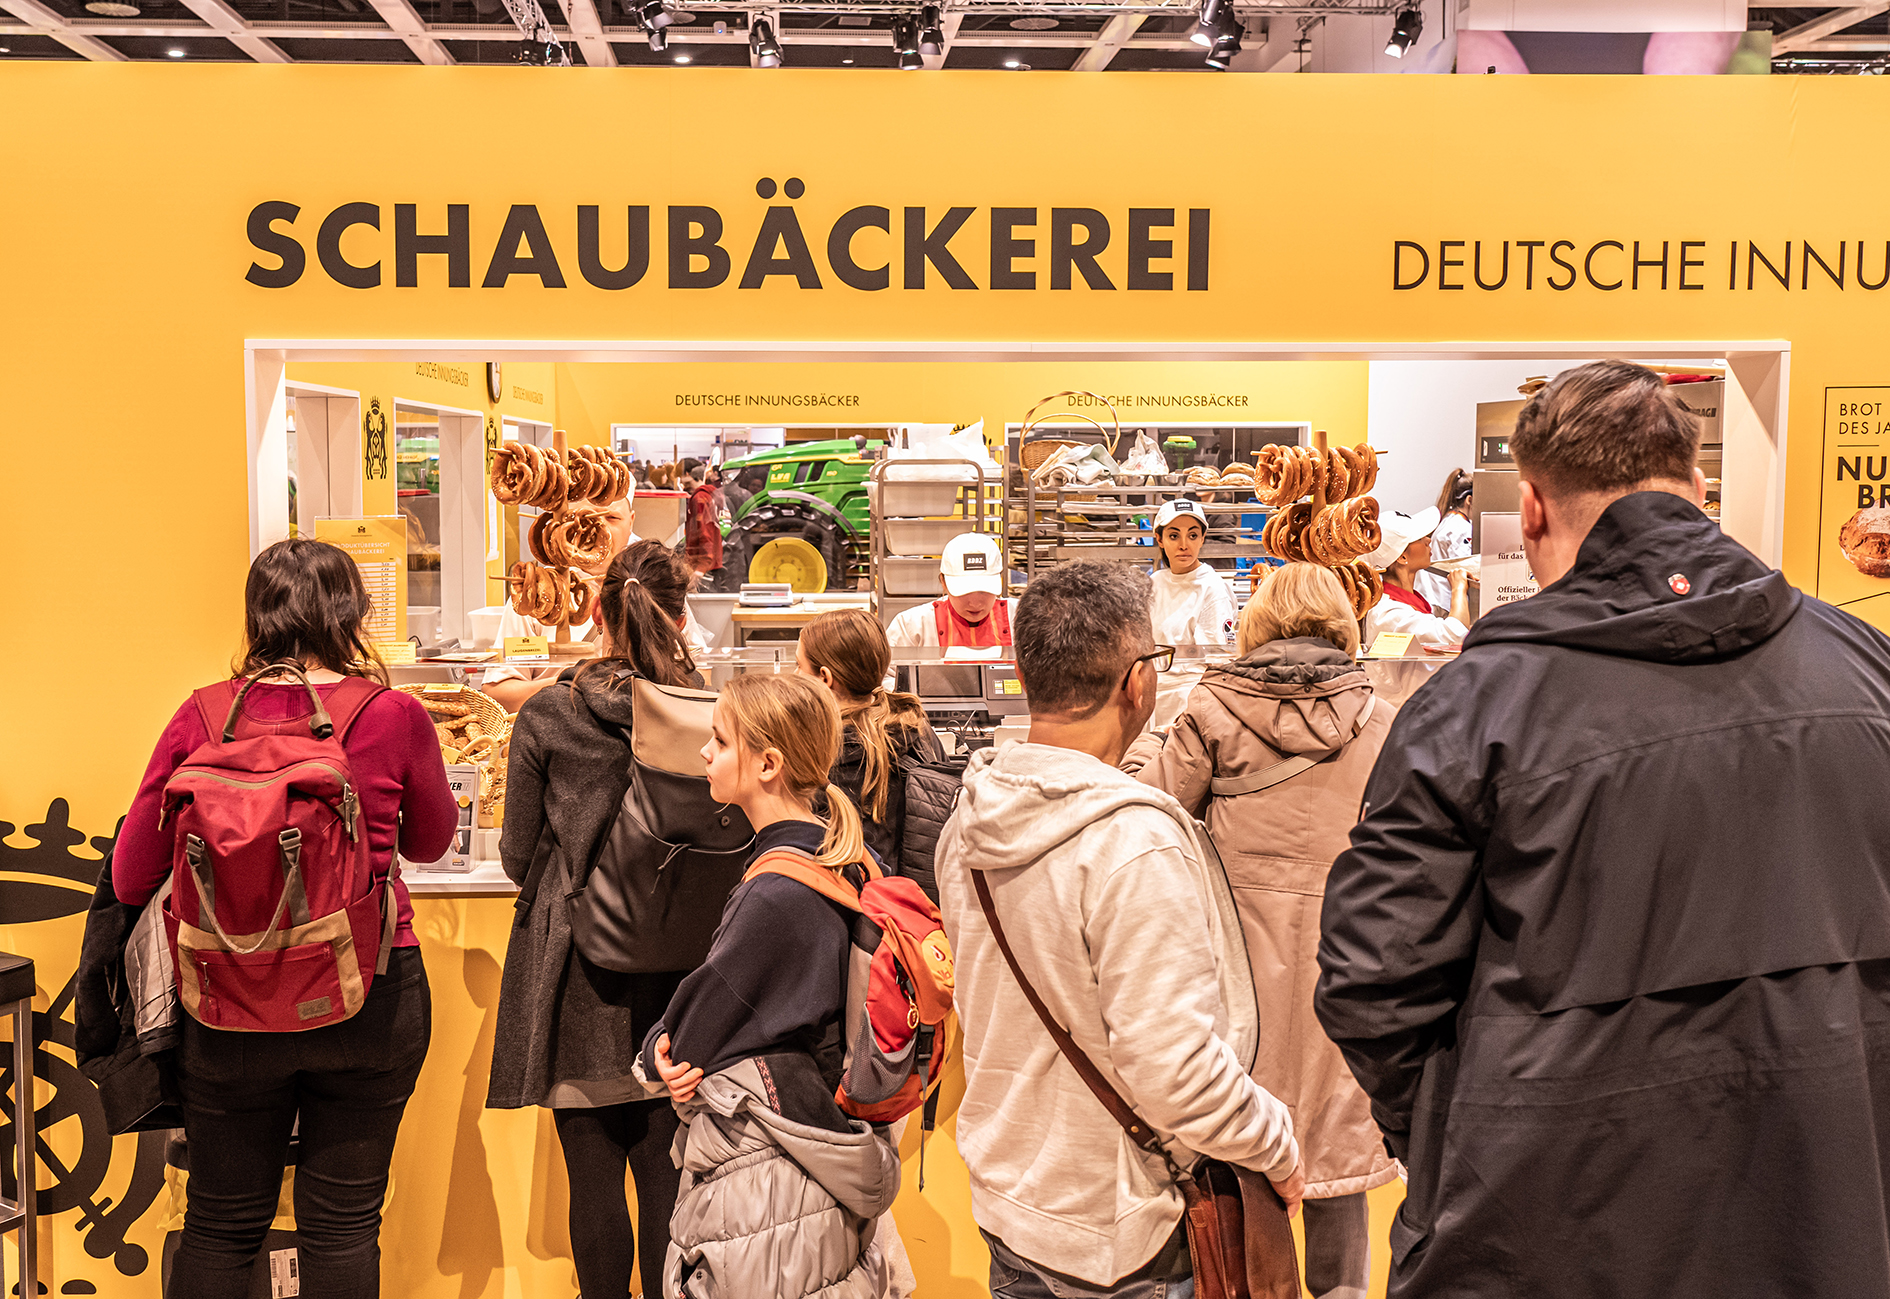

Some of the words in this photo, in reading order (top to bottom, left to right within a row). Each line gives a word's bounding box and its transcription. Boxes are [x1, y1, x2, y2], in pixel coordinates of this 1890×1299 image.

[245, 177, 1211, 291] SCHAUBÄCKEREI
[1393, 239, 1706, 292] DEUTSCHE
[1729, 239, 1890, 292] INNU
[675, 394, 741, 406] DEUTSCHE
[745, 392, 860, 407] INNUNGSBÄCKER
[1068, 395, 1132, 407] DEUTSCHE
[1136, 393, 1249, 407] INNUNGSBÄCKER
[1840, 402, 1882, 416] BROT
[1839, 421, 1869, 435] DES
[1836, 455, 1887, 481] NU
[1498, 552, 1509, 560] für
[1510, 552, 1524, 560] das
